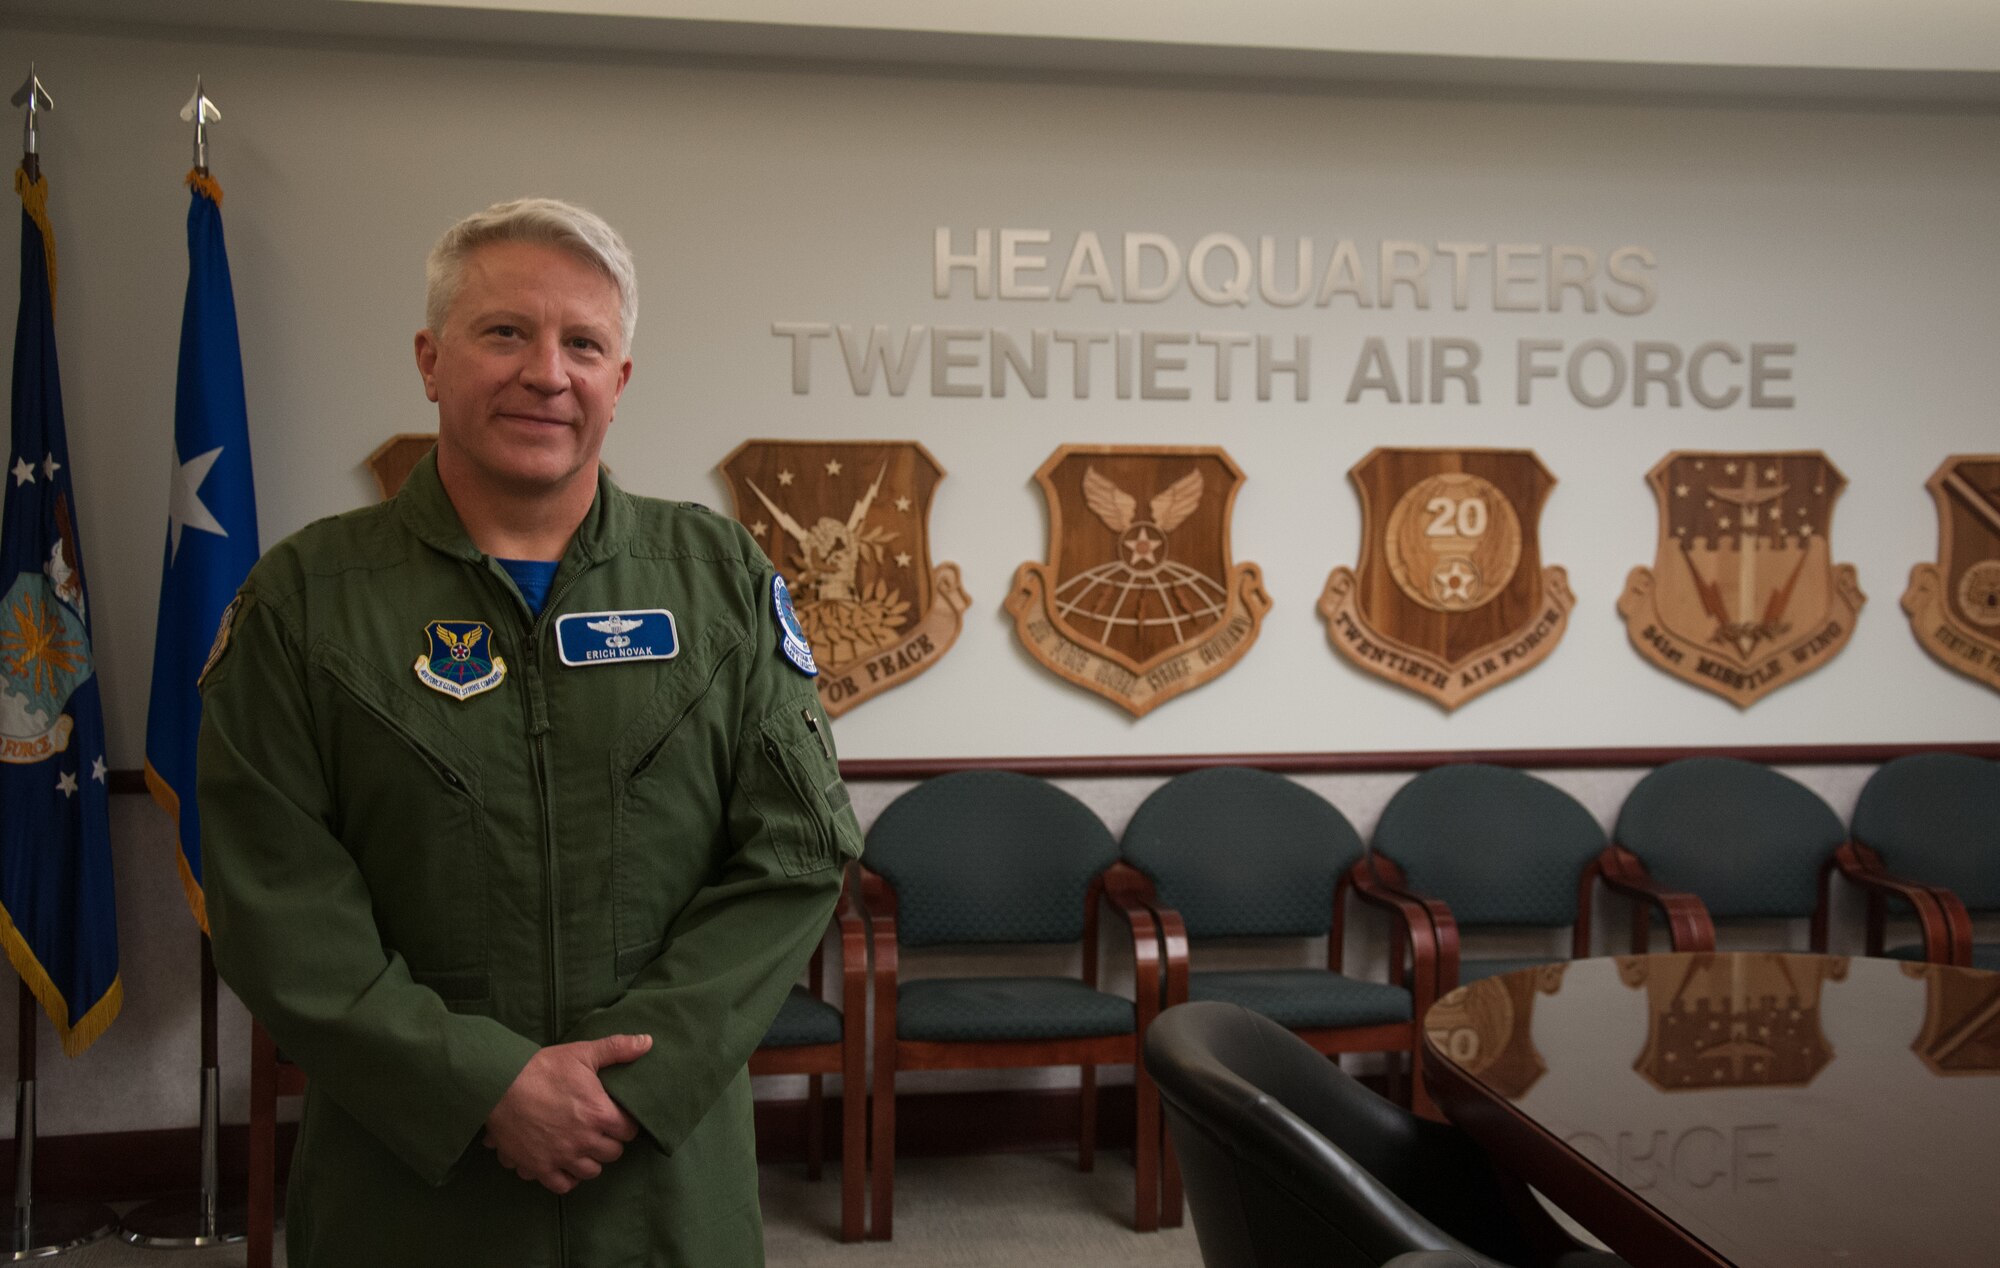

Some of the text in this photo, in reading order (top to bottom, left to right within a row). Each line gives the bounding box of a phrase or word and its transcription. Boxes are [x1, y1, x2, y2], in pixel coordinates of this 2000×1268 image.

[933, 226, 1658, 317] HEADQUARTERS
[771, 322, 1797, 411] TWENTIETH AIR FORCE
[1425, 496, 1488, 537] 20
[585, 646, 653, 660] ERICH NOVAK
[865, 632, 936, 684] PEACE
[1335, 608, 1560, 690] TWENTIETH AIR FORCE
